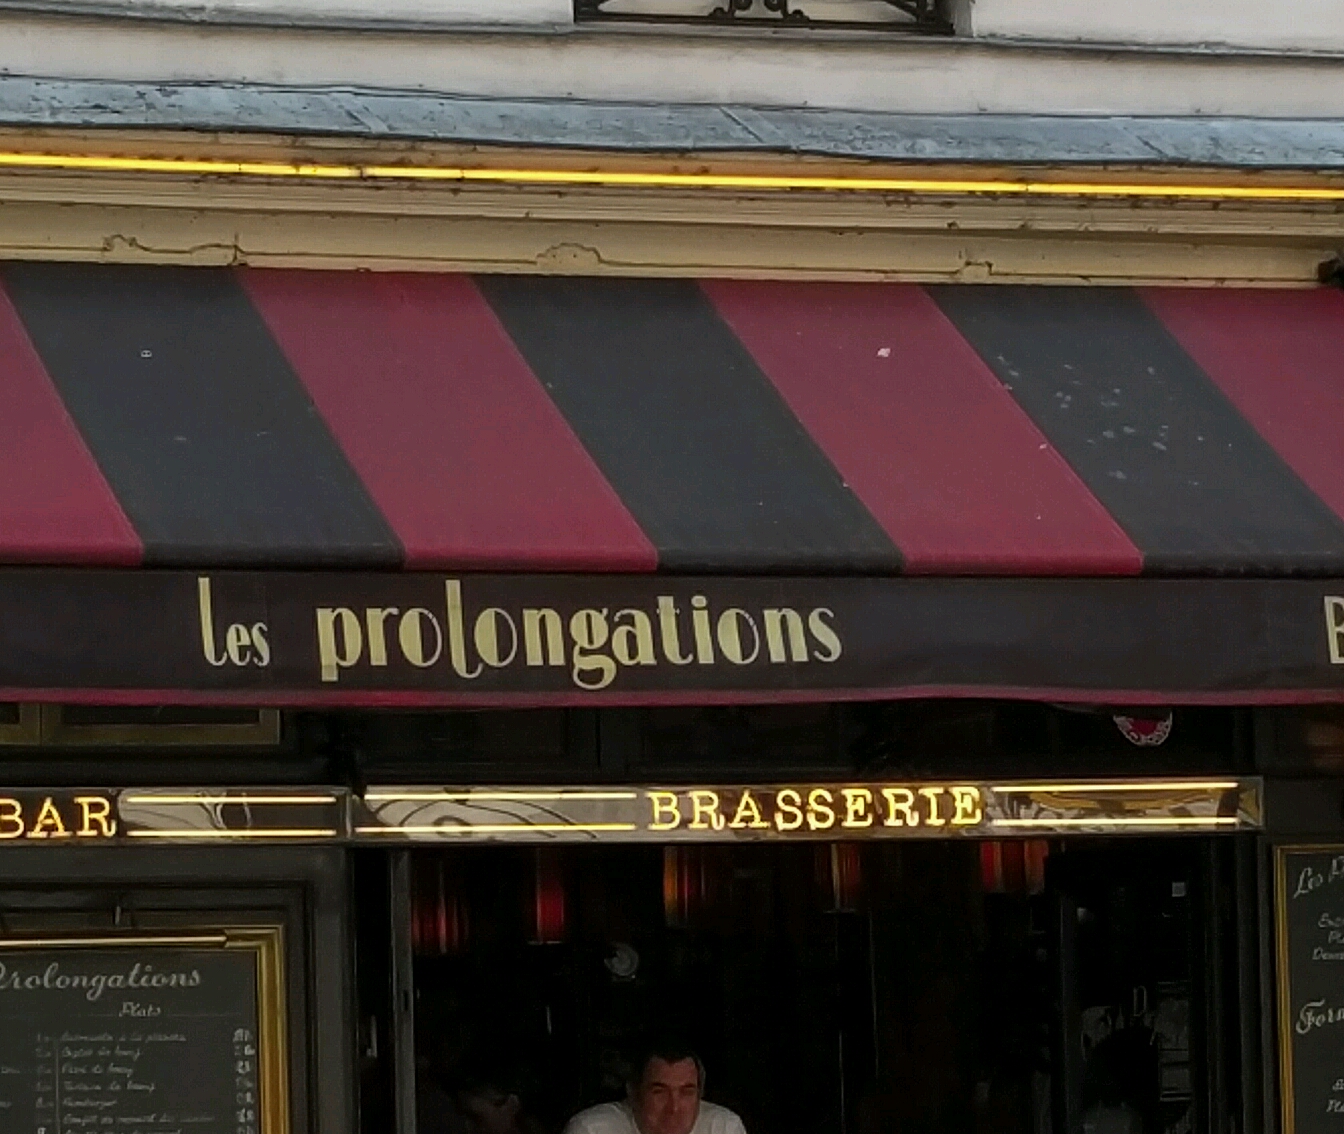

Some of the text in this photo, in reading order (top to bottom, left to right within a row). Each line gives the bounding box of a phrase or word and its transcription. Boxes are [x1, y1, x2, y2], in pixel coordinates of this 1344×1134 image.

[197, 576, 842, 690] les prolongations
[648, 786, 982, 831] BRASSERIE
